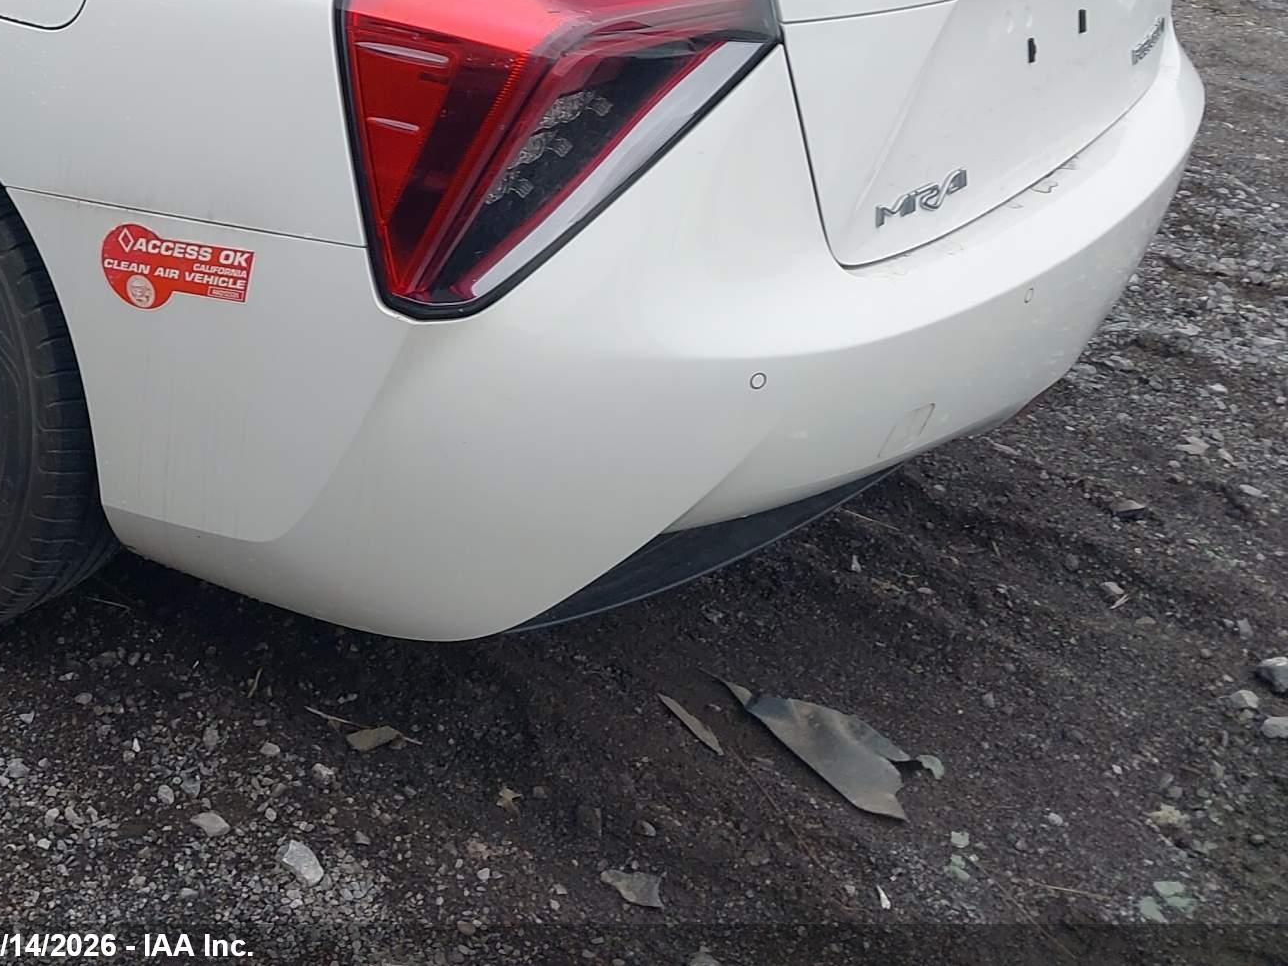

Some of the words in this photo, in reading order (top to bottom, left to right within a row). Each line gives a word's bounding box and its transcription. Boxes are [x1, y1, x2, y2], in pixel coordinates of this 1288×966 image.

[133, 237, 212, 262] ACCESS
[219, 249, 250, 267] OK
[103, 258, 150, 275] CLEAN
[154, 266, 180, 280] AIR
[184, 271, 247, 290] VEHICLE
[193, 263, 247, 279] CALIFORNIA
